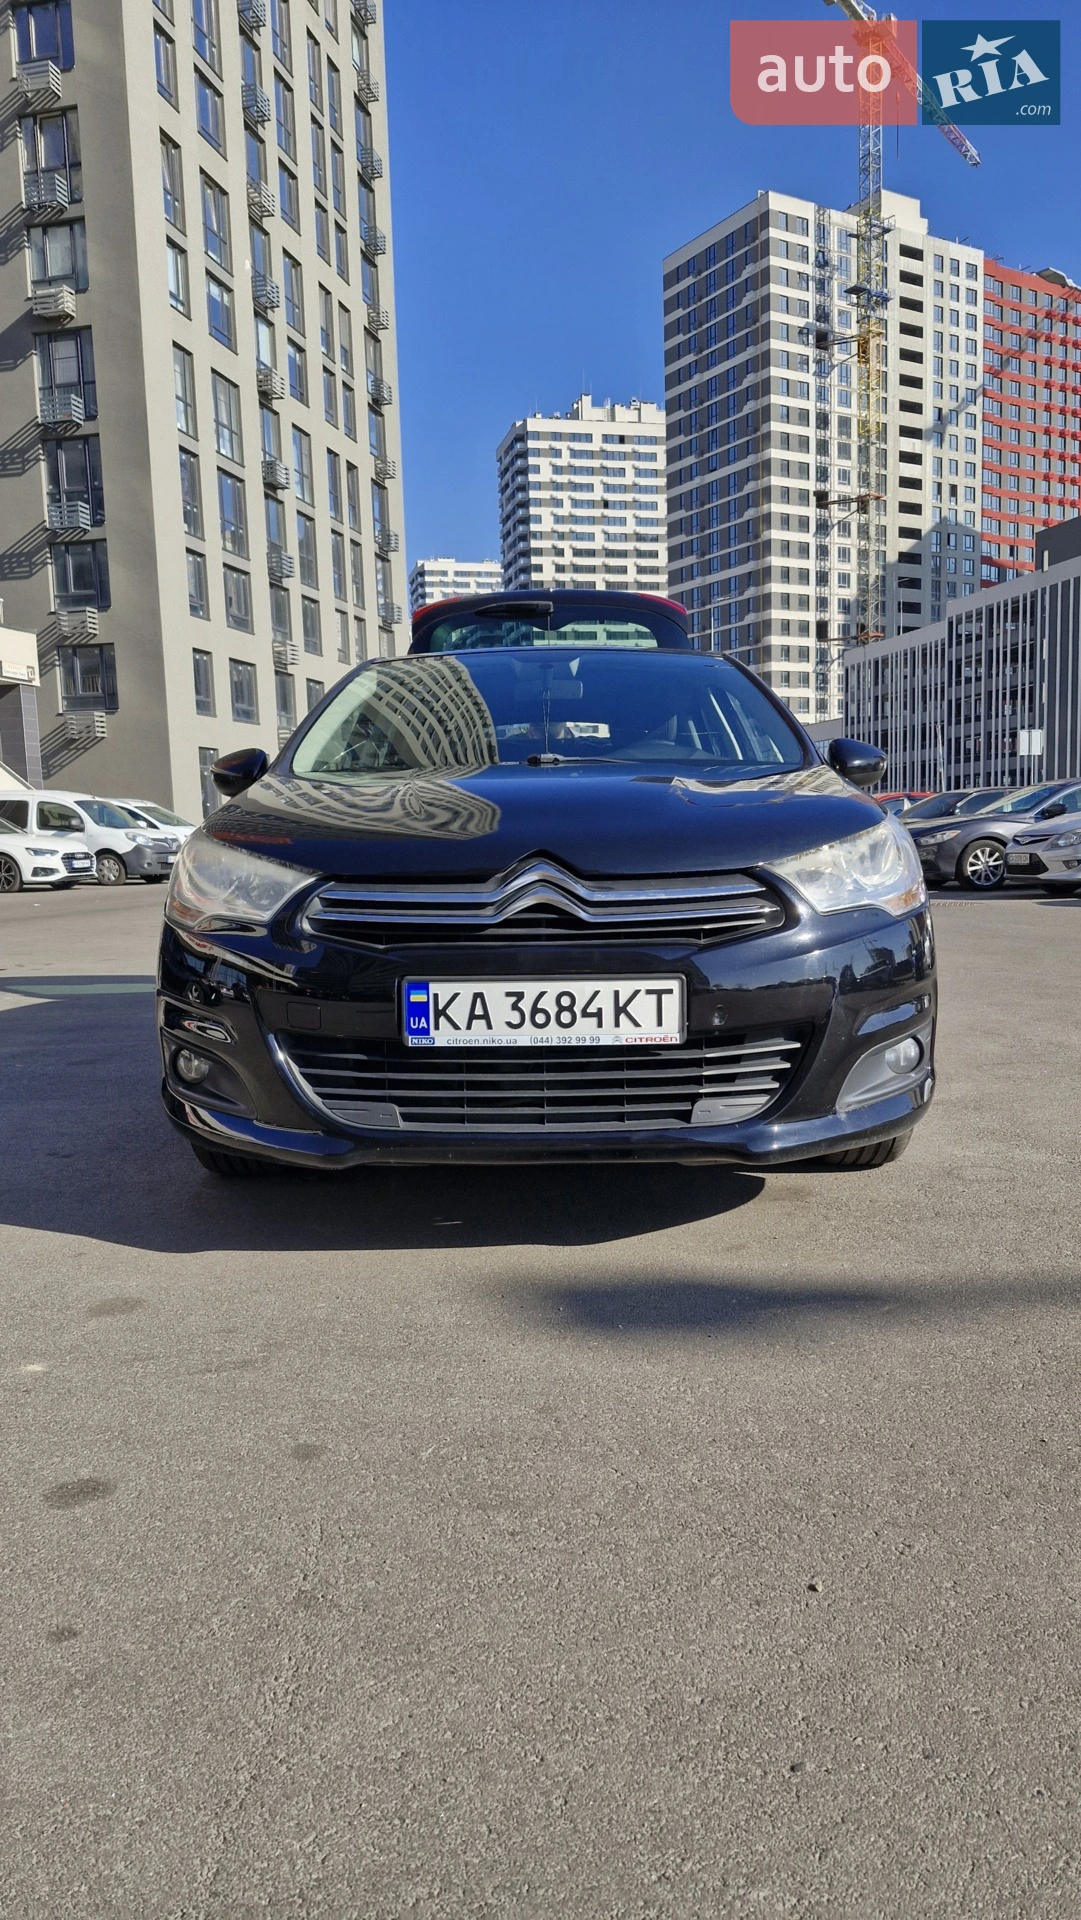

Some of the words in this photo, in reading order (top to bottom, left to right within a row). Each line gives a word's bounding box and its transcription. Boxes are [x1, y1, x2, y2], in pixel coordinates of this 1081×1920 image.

[433, 992, 494, 1031] KA
[505, 990, 604, 1030] 3684
[614, 989, 674, 1028] KT
[410, 1017, 428, 1029] UA
[446, 1036, 518, 1046] citroen.niko.ua
[529, 1036, 553, 1045] (044)
[556, 1036, 572, 1045] 392
[575, 1036, 587, 1045] 99
[589, 1036, 601, 1045] 99
